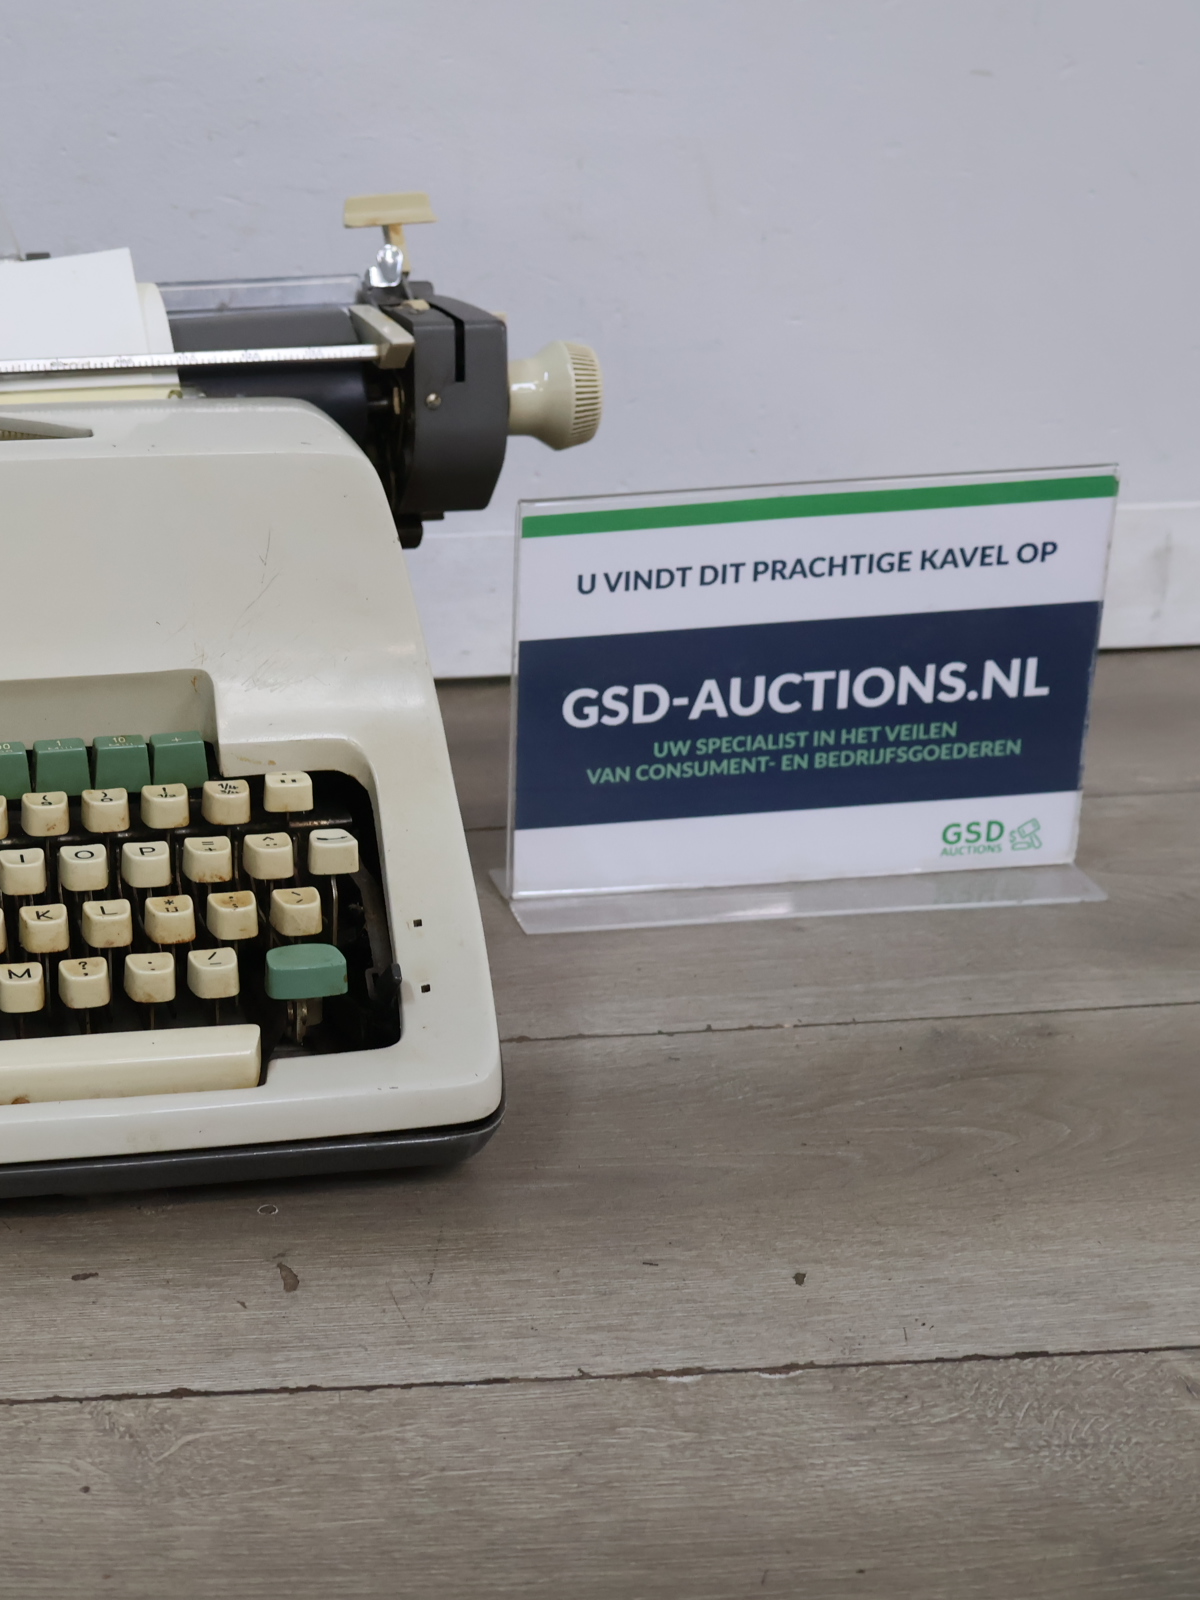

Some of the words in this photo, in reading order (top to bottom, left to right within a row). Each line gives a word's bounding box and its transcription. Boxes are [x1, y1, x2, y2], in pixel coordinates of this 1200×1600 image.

[577, 573, 596, 595] U
[603, 566, 693, 593] VINDT
[699, 562, 746, 586] DIT
[753, 551, 913, 582] PRACHTIGE
[920, 544, 1009, 571] KAVEL
[1016, 541, 1058, 564] OP
[562, 656, 1050, 728] GSD-AUCTIONS.NL
[653, 739, 691, 758] UW
[695, 730, 810, 755] SPECIALIST
[813, 729, 836, 747] IN
[841, 726, 882, 745] HET
[884, 721, 958, 743] VEILEN
[587, 766, 631, 785] VAN
[635, 755, 776, 782] CONSUMENT-
[780, 753, 809, 771] EN
[814, 738, 1022, 769] BEDRIJFSGOEDEREN
[942, 820, 1005, 845] GSD
[20, 854, 26, 864] I
[74, 850, 95, 860] O
[139, 846, 156, 856] P
[940, 844, 1003, 857] AUCTIONS
[35, 910, 54, 920] K
[100, 905, 118, 916] L
[8, 968, 32, 980] M
